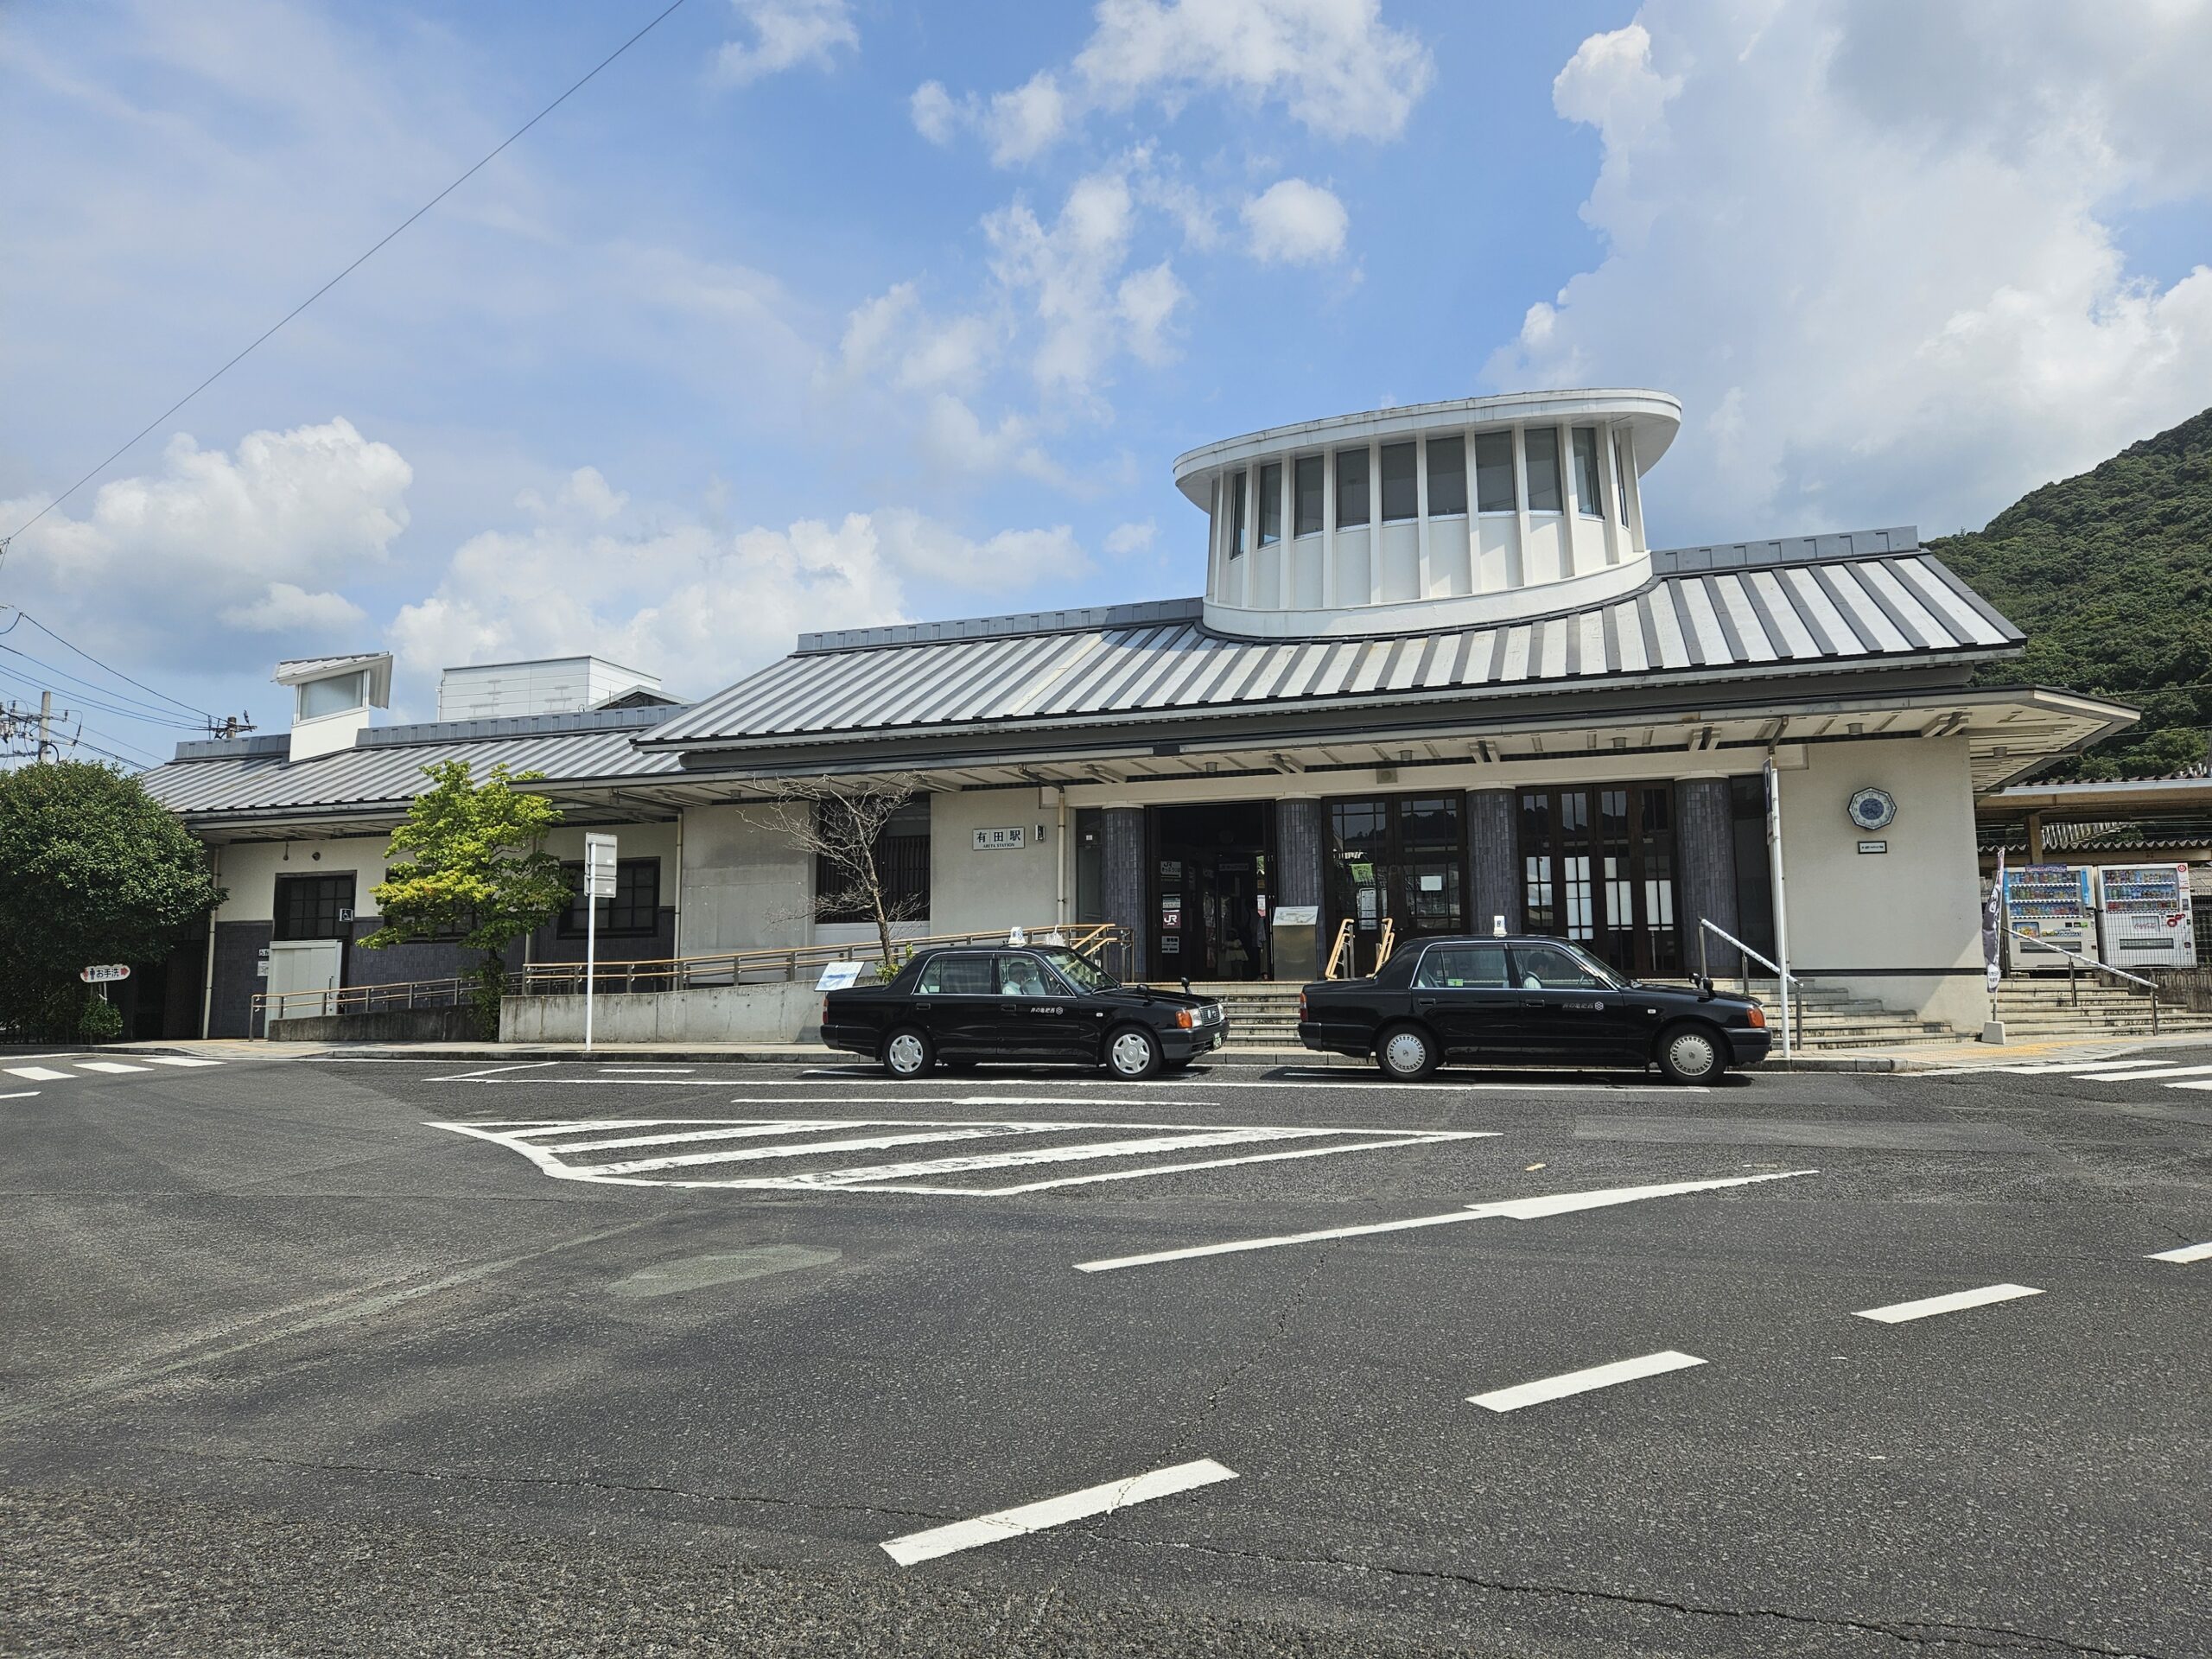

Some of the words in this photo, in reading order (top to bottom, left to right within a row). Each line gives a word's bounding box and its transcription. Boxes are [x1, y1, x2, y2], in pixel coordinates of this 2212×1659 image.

[976, 830, 1021, 843] 有田駅
[1164, 914, 1178, 923] JR
[97, 968, 119, 978] お手洗
